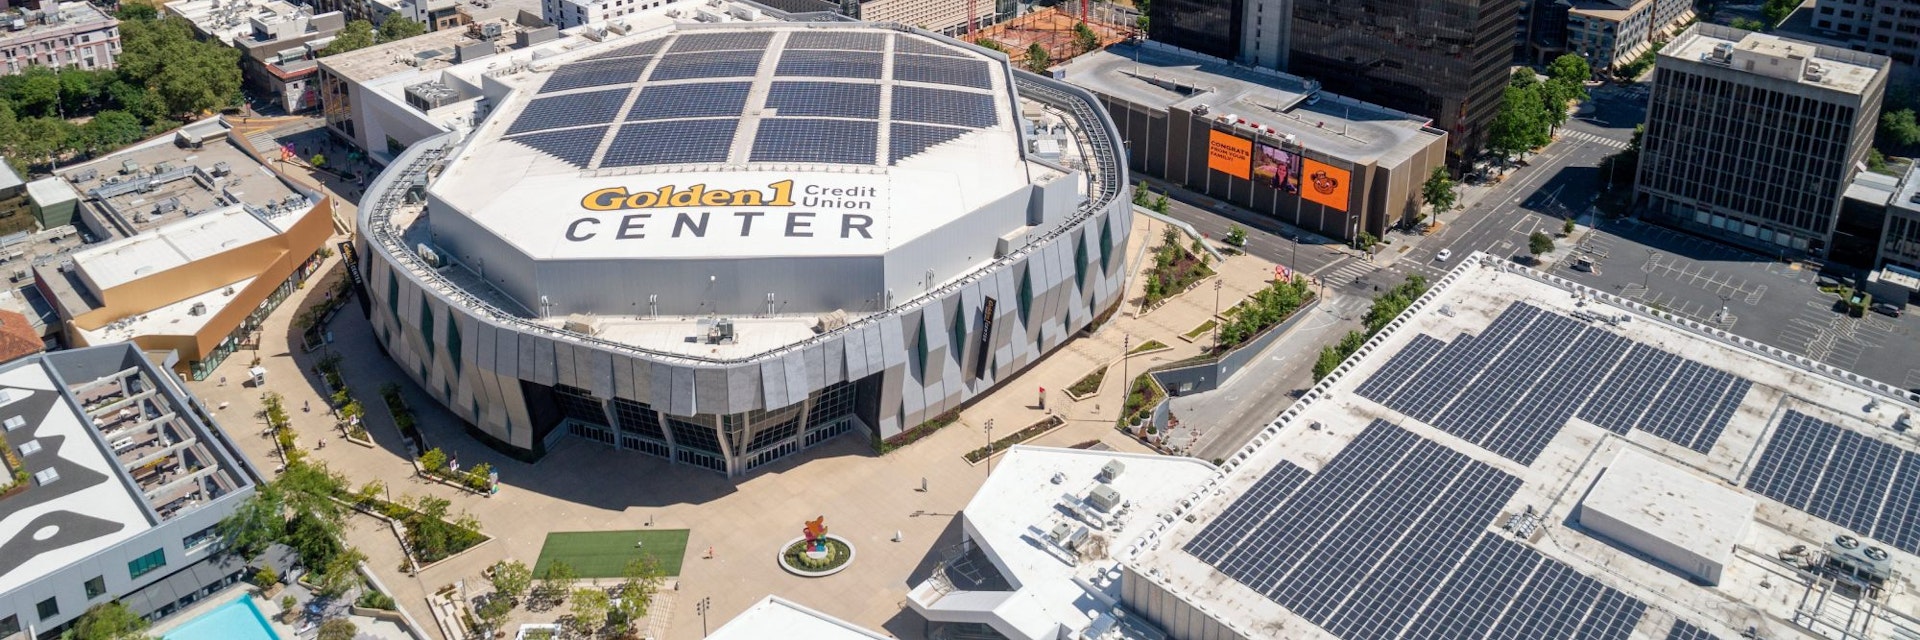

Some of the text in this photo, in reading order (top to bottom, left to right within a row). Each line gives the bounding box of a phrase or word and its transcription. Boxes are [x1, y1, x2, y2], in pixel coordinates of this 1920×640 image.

[1211, 141, 1249, 156] CONGRATS
[1211, 147, 1245, 160] FROM YOUR
[1211, 151, 1233, 161] FAMILY!
[805, 184, 876, 197] Credit
[803, 196, 871, 209] Union
[565, 212, 873, 242] CENTER
